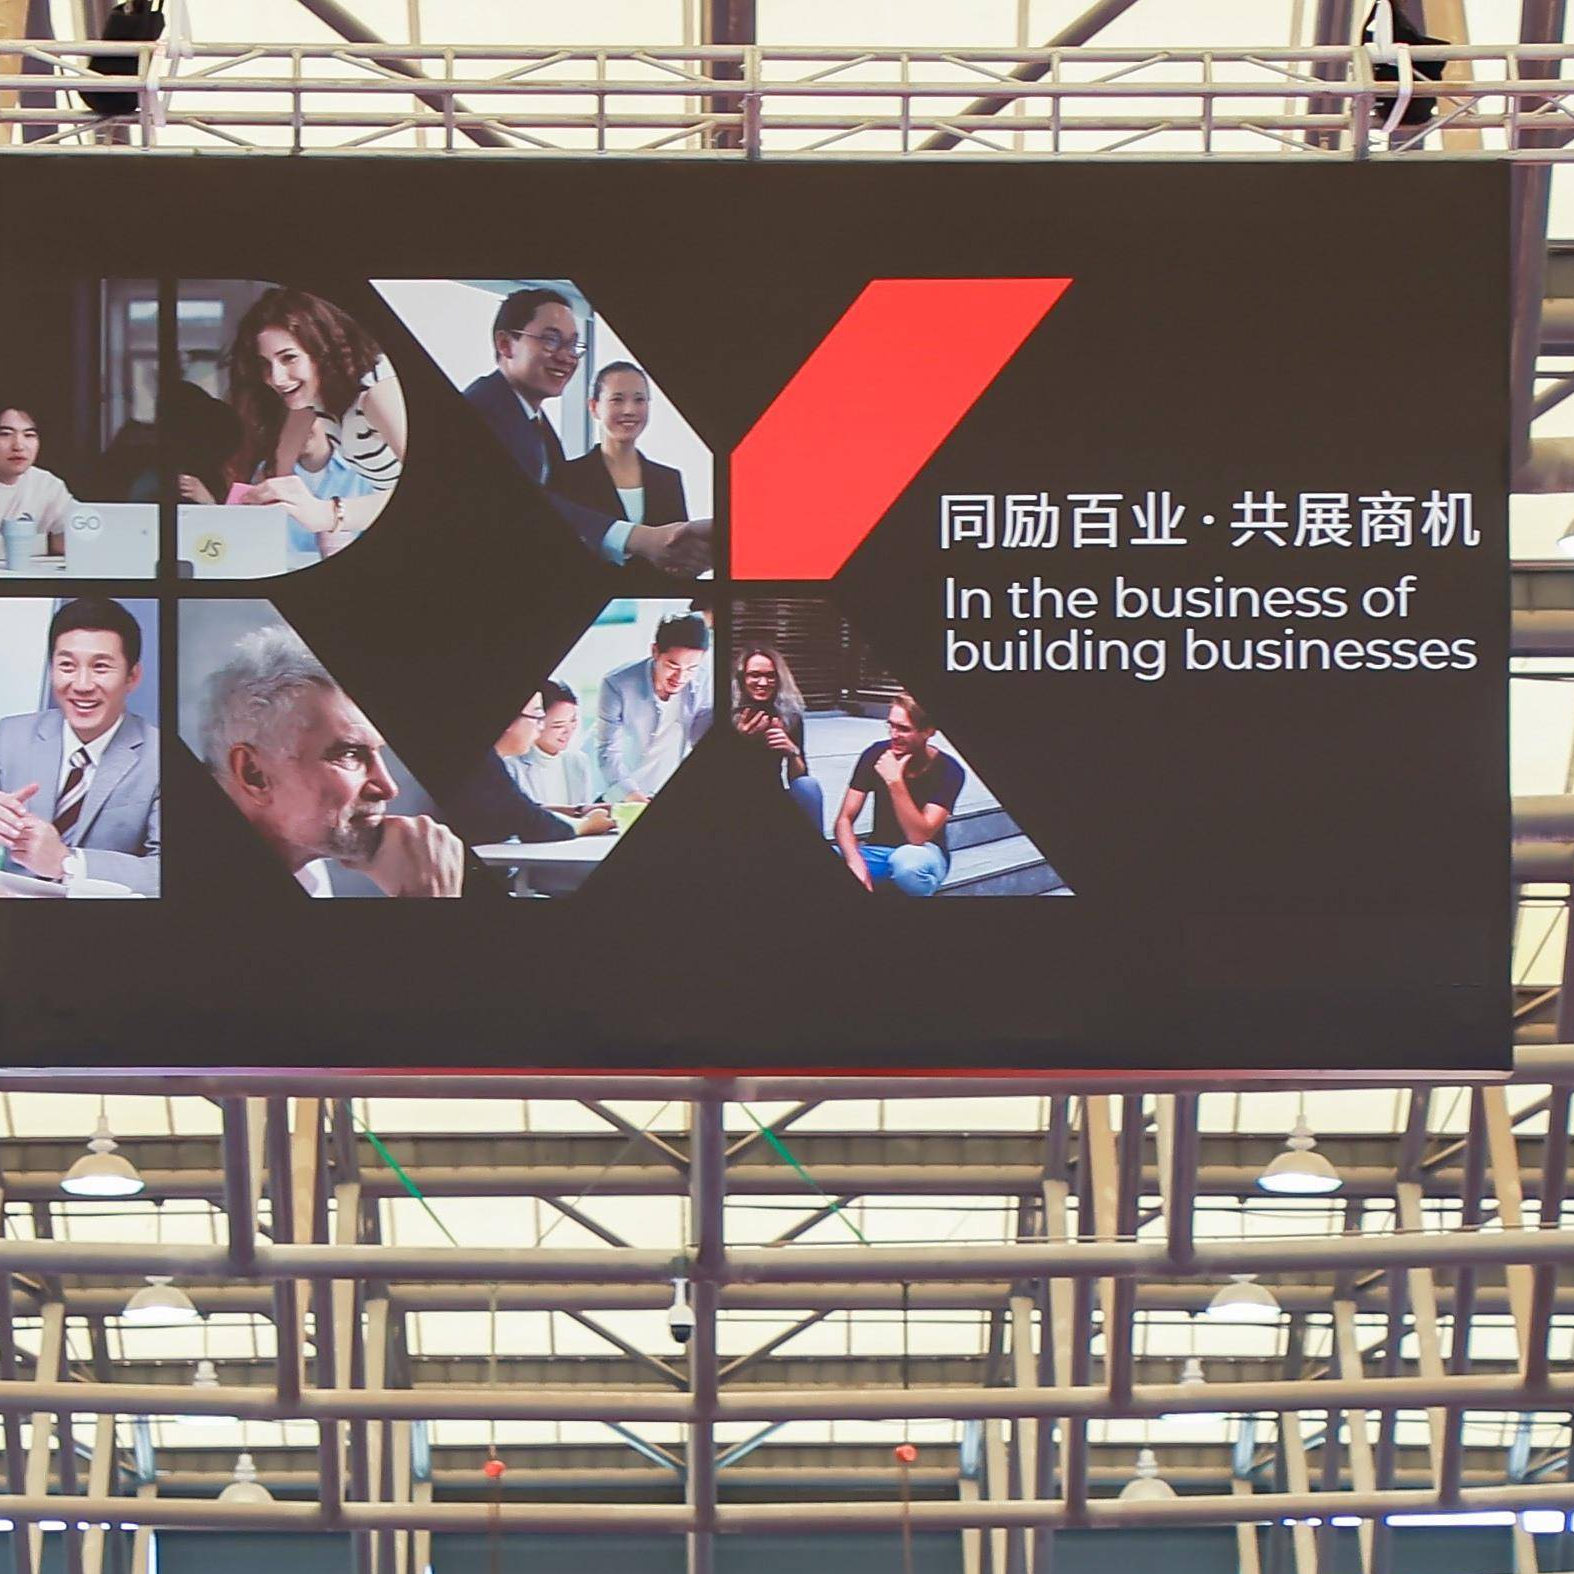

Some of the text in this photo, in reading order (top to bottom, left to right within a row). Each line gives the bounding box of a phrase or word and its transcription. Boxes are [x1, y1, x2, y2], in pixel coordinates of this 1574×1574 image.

[939, 490, 1481, 549] 同励百业·共展商机
[945, 574, 1417, 619] In the business of
[945, 629, 1478, 679] building businesses
